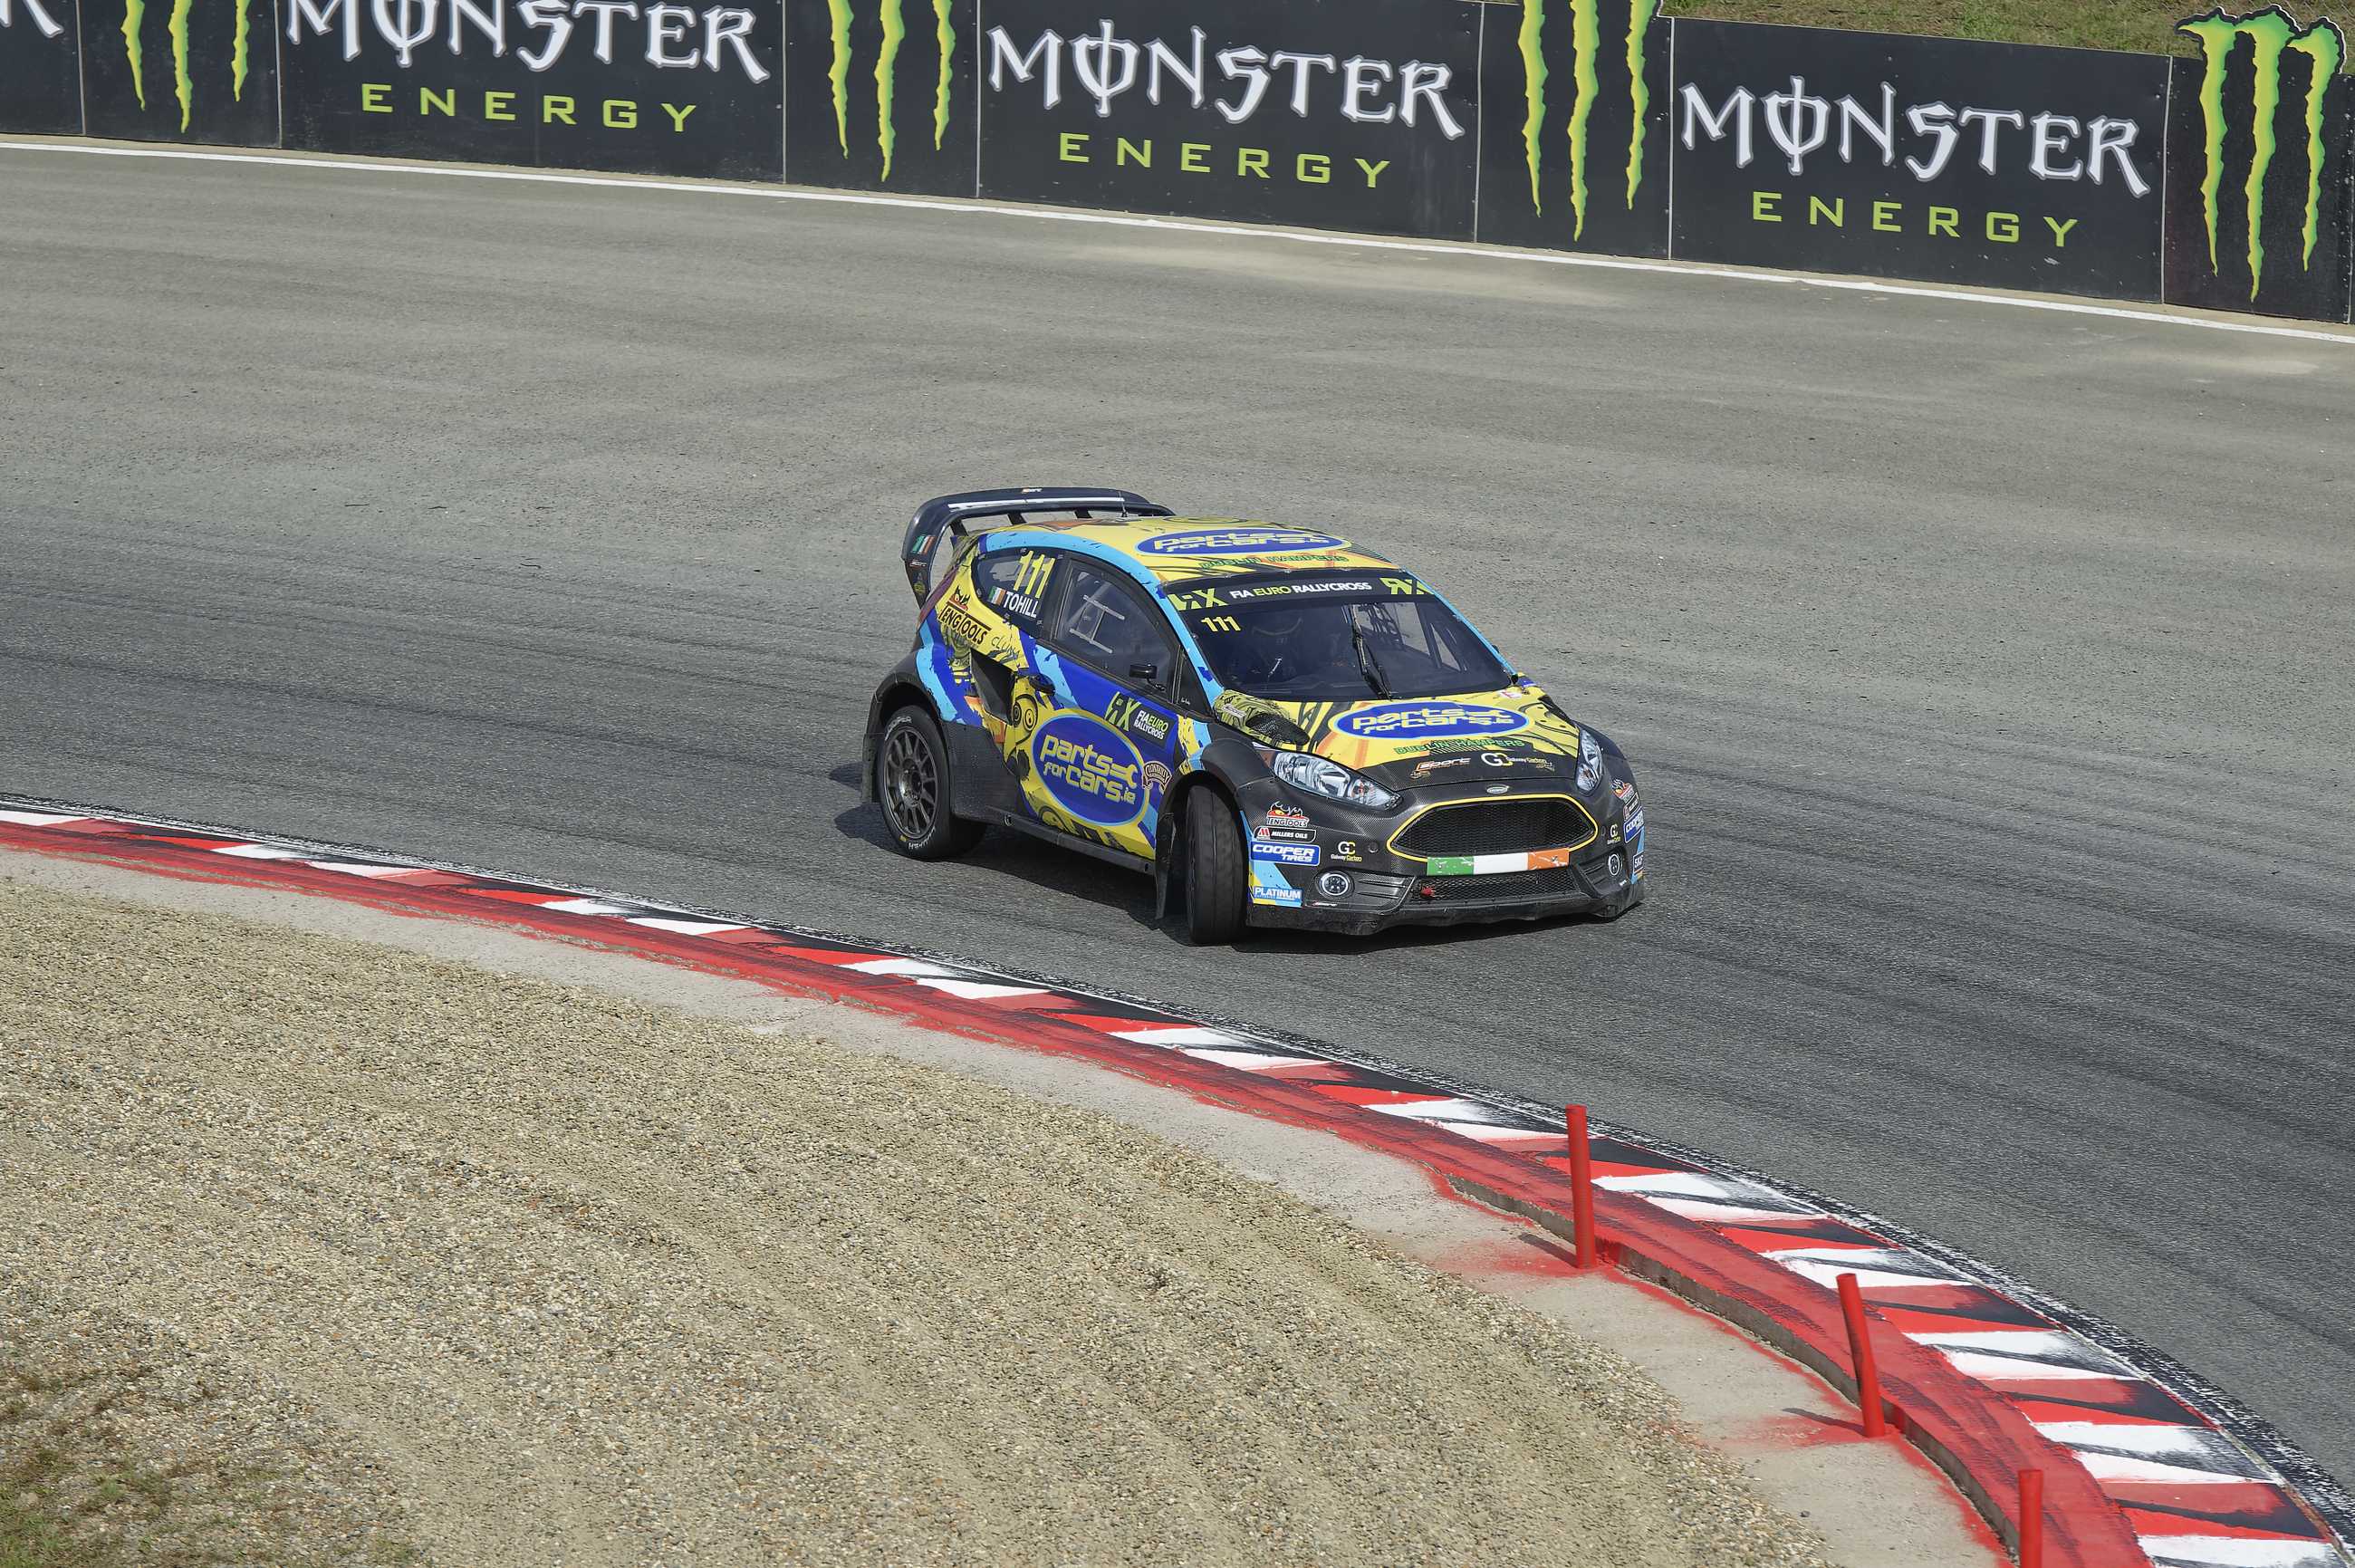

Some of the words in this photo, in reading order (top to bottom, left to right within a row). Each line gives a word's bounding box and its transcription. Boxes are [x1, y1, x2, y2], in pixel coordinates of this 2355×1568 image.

[286, 0, 770, 83] MONSTER
[988, 19, 1466, 140] MONSTER
[362, 84, 697, 132] ENERGY
[1679, 75, 2151, 197] MONSTER
[1059, 132, 1390, 188] ENERGY
[1752, 191, 2079, 247] ENERGY
[1014, 551, 1056, 599] 111
[1229, 590, 1254, 599] FIA
[1254, 586, 1292, 596] EURO
[1291, 582, 1372, 593] RALLYCROSS
[1003, 591, 1039, 618] TOHILL
[1201, 616, 1242, 632] 111
[1105, 691, 1141, 731] RX
[1352, 707, 1465, 730] parts
[1134, 718, 1165, 740] RALLYCROSS
[1363, 722, 1399, 735] for
[1040, 735, 1112, 776] parts
[1393, 740, 1450, 755] DUBLIN
[1450, 738, 1525, 752] HAMPERS
[1043, 761, 1066, 778] for
[1271, 831, 1294, 839] MILLERS
[1253, 843, 1314, 857] COOPER
[1282, 854, 1312, 862] TIRES
[1254, 887, 1302, 899] PLATINUM
